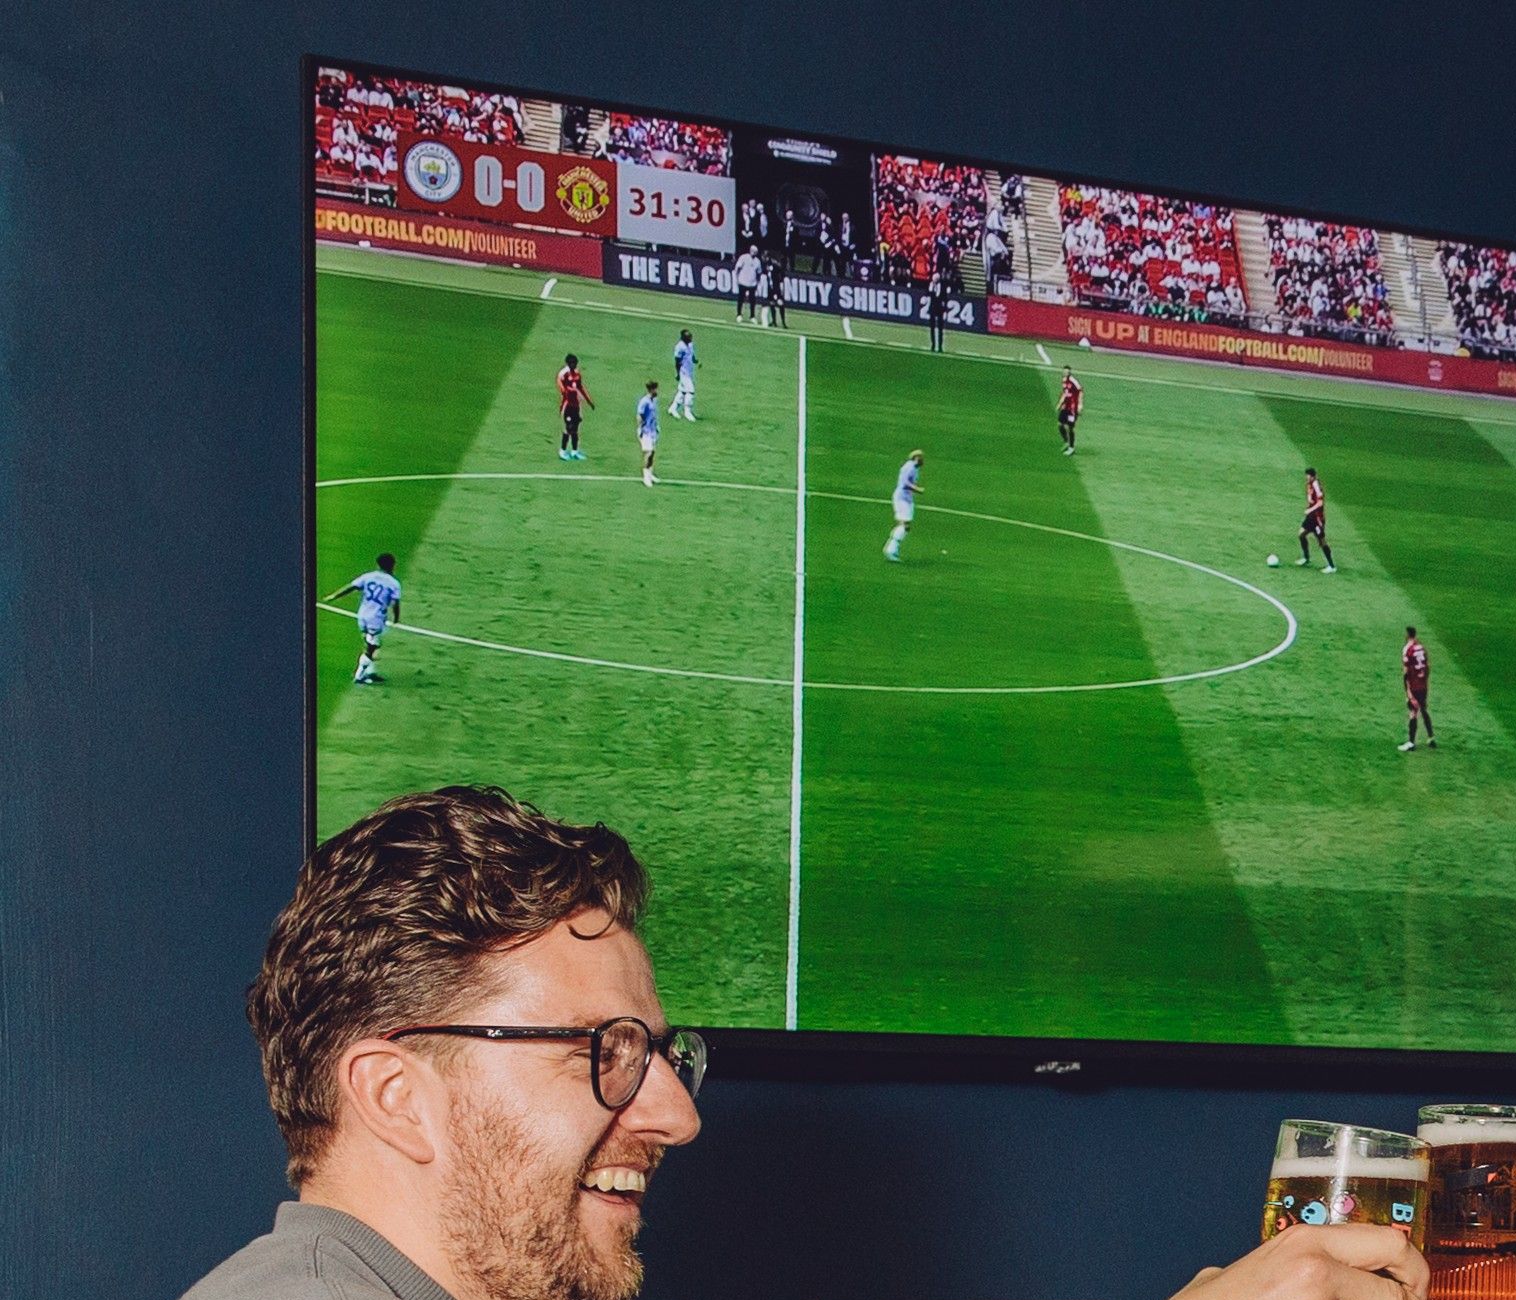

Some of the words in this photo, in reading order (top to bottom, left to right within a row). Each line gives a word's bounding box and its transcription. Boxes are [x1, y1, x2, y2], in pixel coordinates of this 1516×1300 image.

[473, 154, 545, 213] 0-0
[629, 187, 725, 228] 31:30
[618, 253, 660, 284] THE
[667, 260, 696, 289] FA
[701, 265, 832, 308] COMNITY
[838, 284, 912, 318] SHIELD
[919, 296, 974, 326] 224
[1067, 315, 1091, 337] SIGN
[1095, 319, 1135, 341] UP
[1138, 324, 1150, 343] AT
[1153, 328, 1373, 372] ENGLANDFOOTBALL.COM/VOLUNTEER
[366, 581, 384, 606] 52
